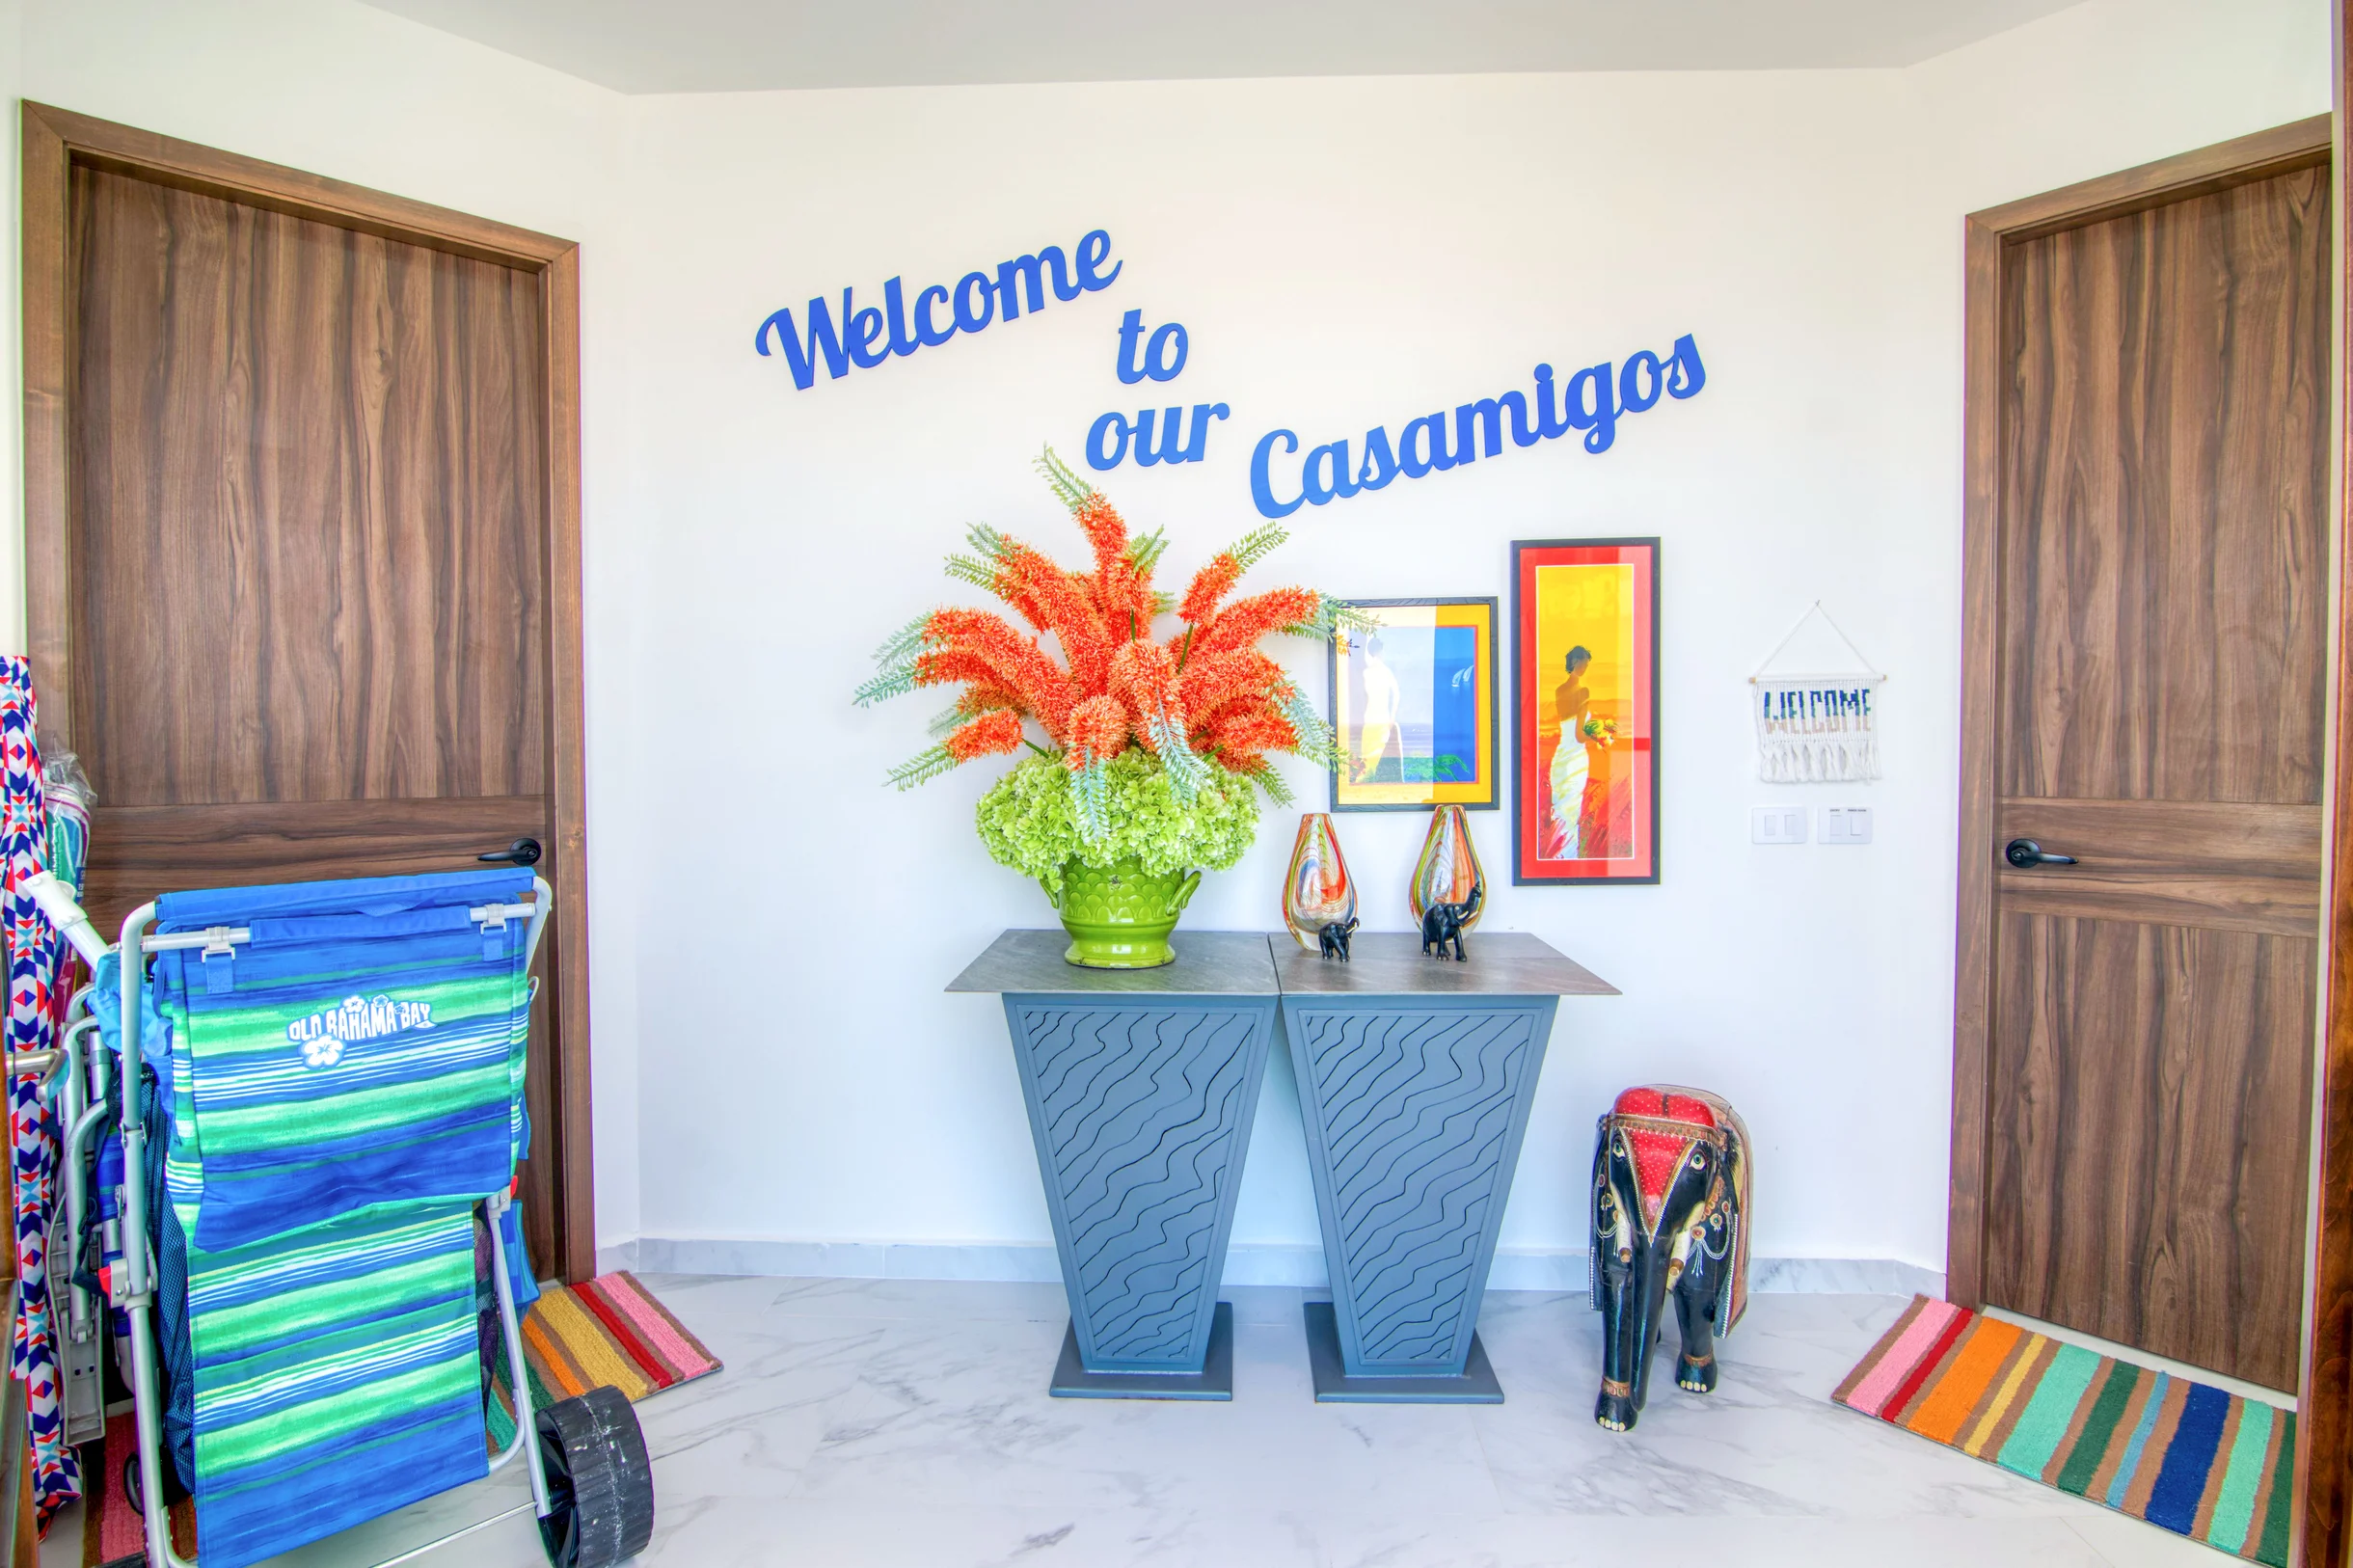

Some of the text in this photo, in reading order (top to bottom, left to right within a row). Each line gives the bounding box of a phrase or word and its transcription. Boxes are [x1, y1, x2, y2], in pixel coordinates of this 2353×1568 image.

[754, 229, 1123, 390] Welcome
[1116, 308, 1189, 386] to
[1085, 333, 1706, 519] our Casamigos
[1764, 689, 1872, 735] WELCOME
[289, 1001, 431, 1041] OLD BAHAMA BAY
